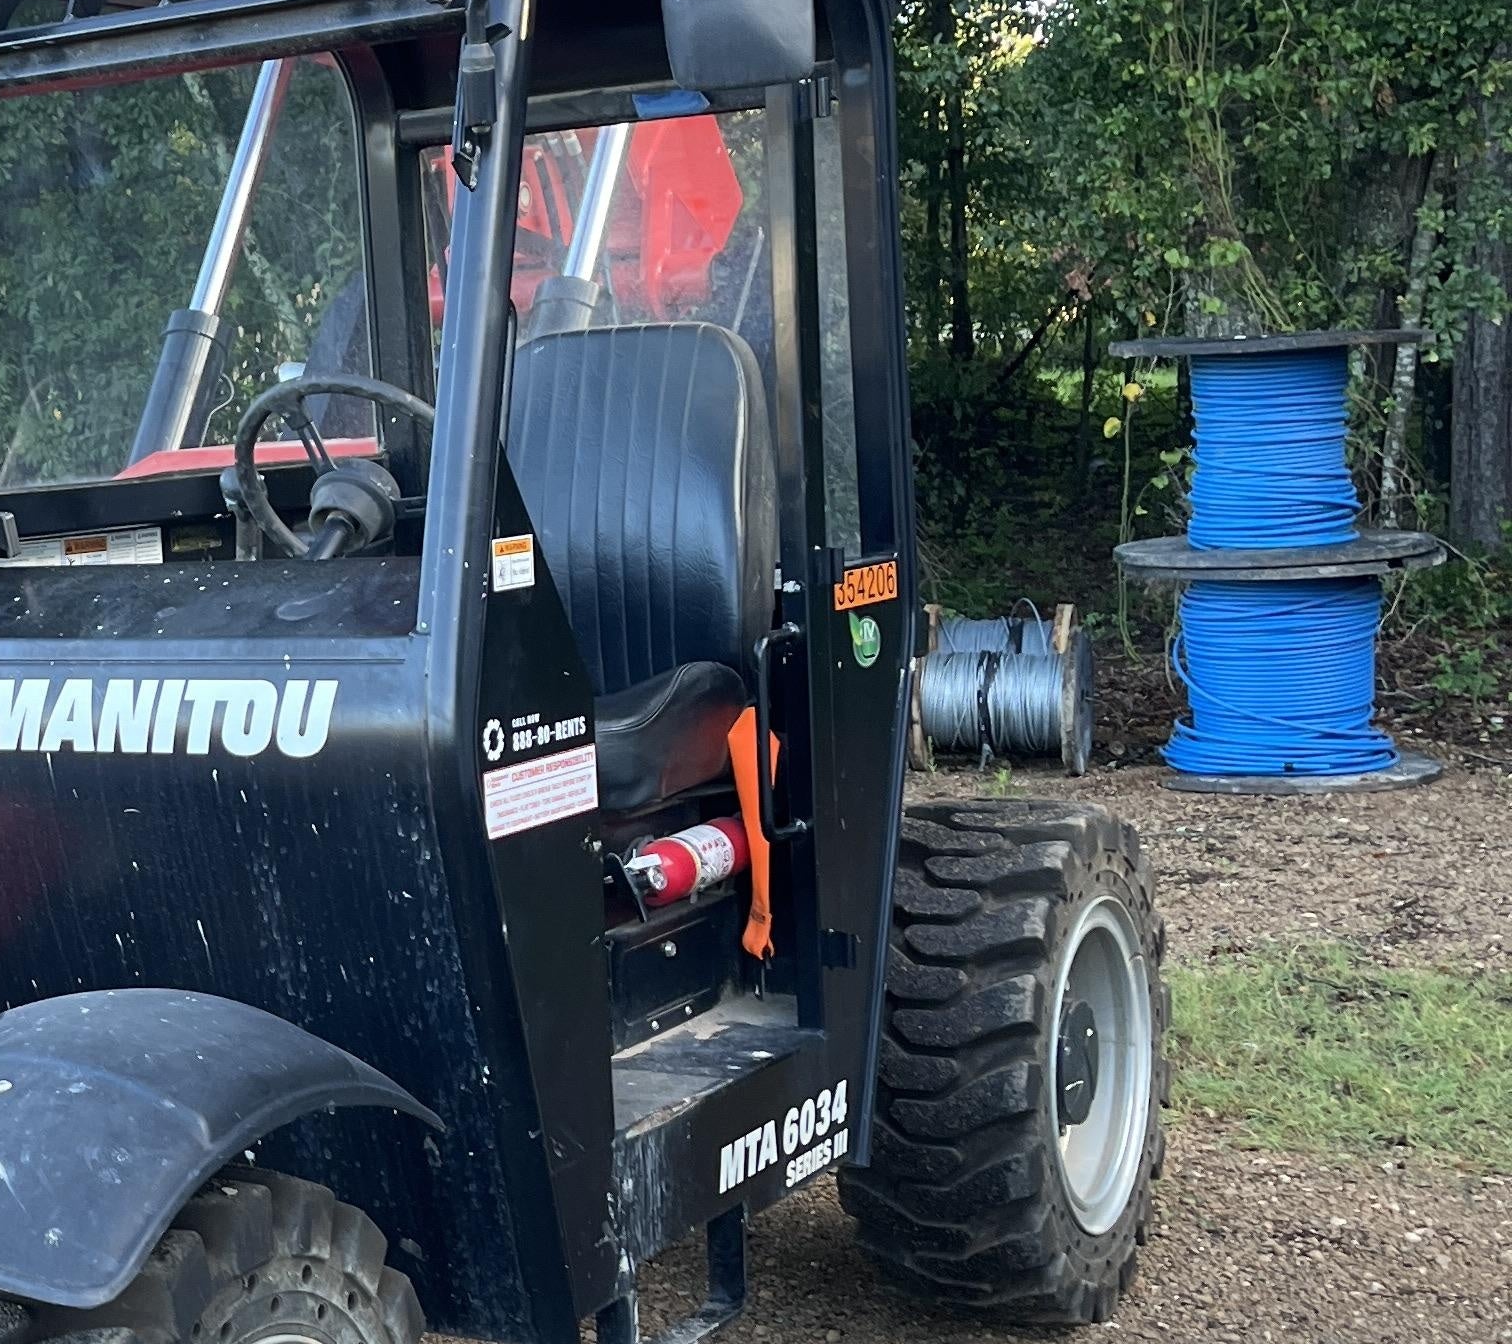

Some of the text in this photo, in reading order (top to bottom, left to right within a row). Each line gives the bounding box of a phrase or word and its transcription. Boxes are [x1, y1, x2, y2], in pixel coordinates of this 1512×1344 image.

[837, 563, 895, 606] 354206
[512, 715, 586, 752] 888-80-RENTS
[719, 1078, 848, 1195] MTA 6034
[785, 1127, 848, 1188] SERIES III
